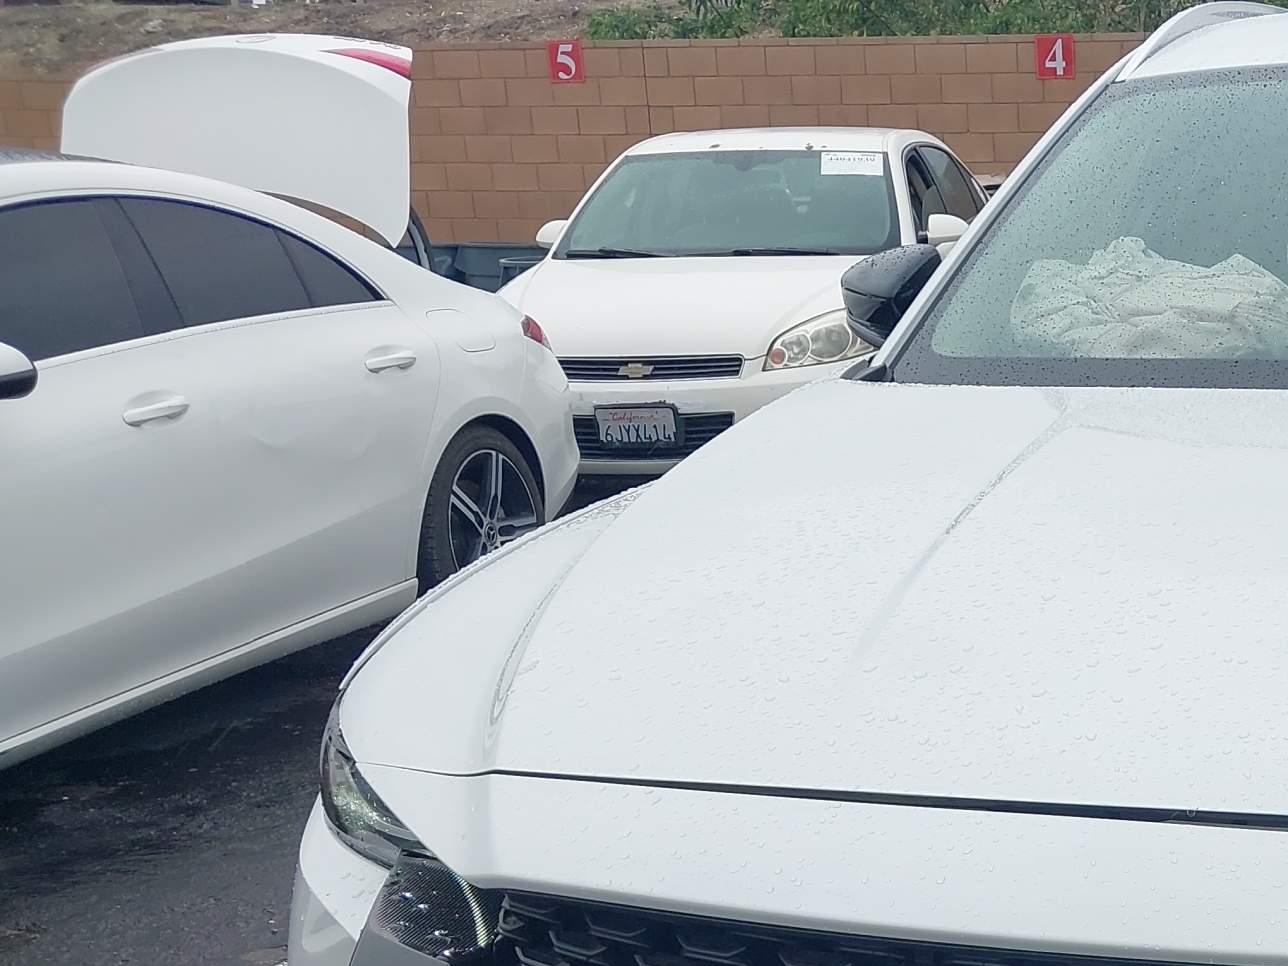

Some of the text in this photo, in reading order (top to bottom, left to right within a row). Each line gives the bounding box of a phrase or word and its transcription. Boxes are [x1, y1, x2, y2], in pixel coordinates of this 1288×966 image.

[556, 44, 576, 79] 5
[1045, 38, 1066, 75] 4
[611, 411, 656, 423] California
[604, 424, 673, 442] 6JYX414
